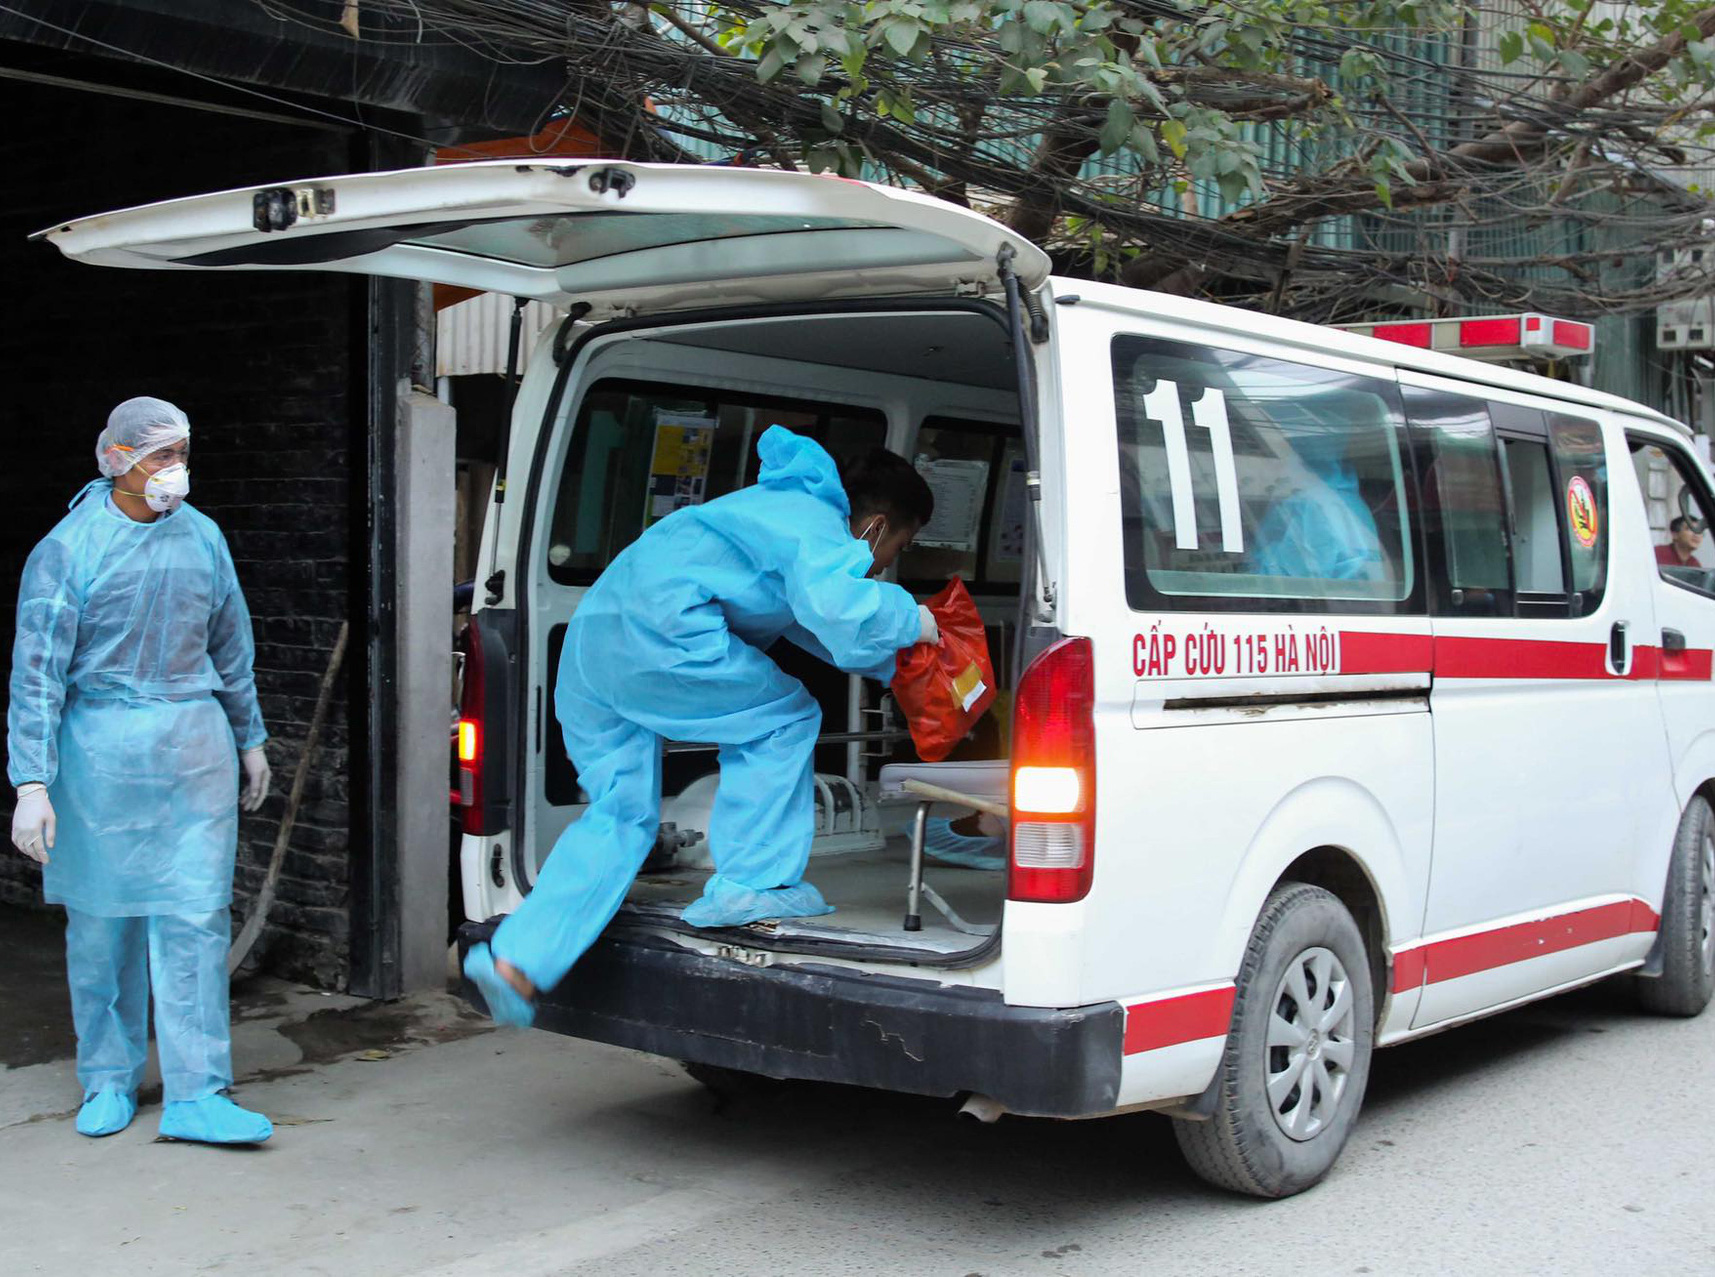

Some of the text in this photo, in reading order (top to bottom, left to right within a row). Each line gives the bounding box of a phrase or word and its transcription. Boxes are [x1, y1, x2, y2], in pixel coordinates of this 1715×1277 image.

[1143, 379, 1244, 553] 11
[1133, 620, 1335, 677] CẤP CỨU 115 HÀ NỘI
